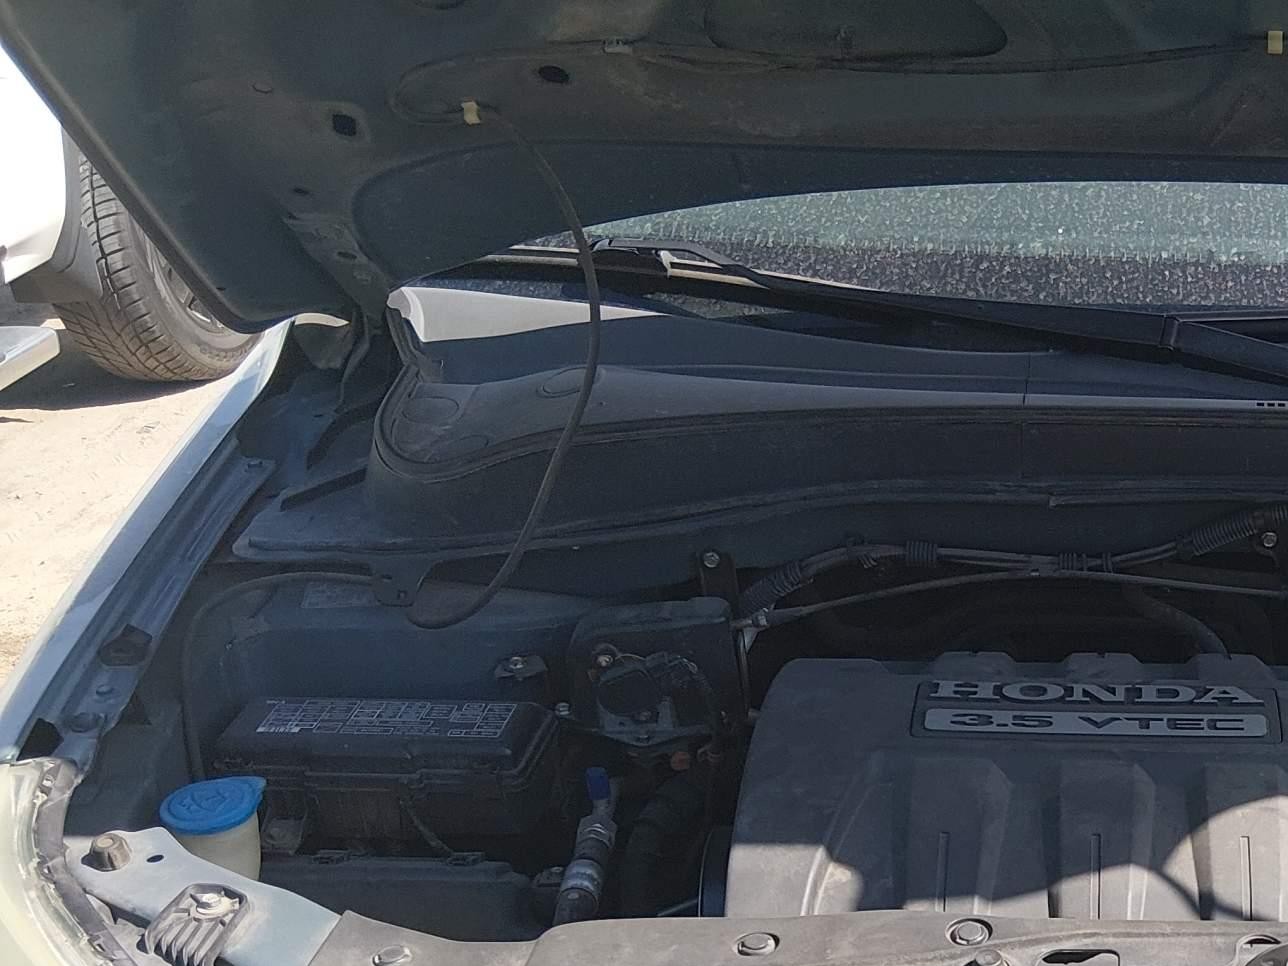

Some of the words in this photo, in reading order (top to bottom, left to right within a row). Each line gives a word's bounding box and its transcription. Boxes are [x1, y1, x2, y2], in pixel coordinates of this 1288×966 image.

[927, 679, 1265, 706] HONDA
[949, 713, 1054, 729] 3.5
[1078, 715, 1245, 731] VTEC
